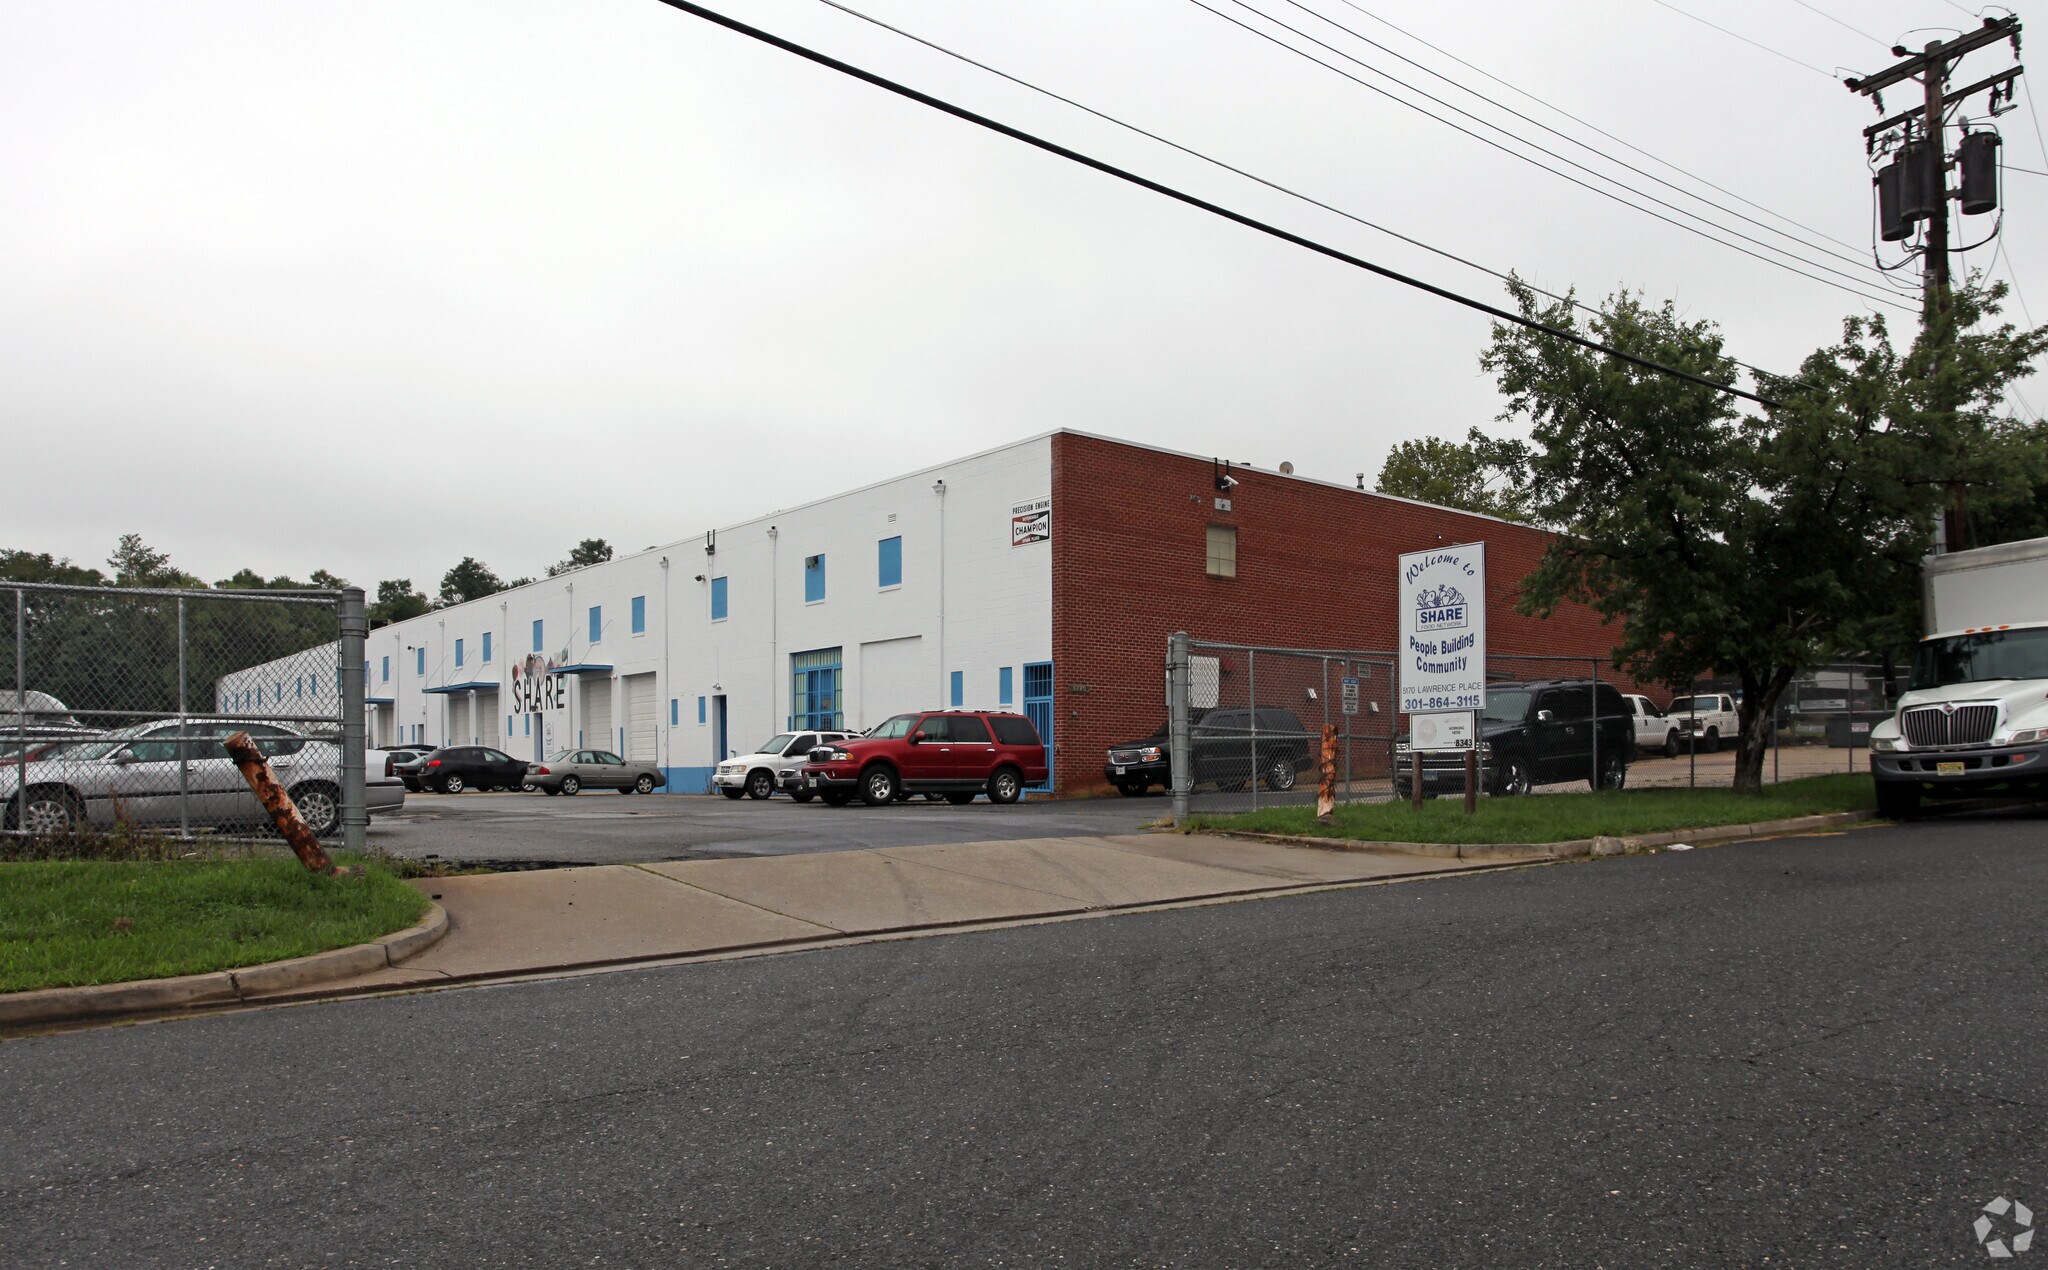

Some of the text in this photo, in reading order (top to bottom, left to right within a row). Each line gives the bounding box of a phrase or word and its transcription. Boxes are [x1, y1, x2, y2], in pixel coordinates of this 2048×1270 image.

[1012, 500, 1050, 515] PRECISION ENGINE
[1015, 521, 1047, 536] CHAMPION
[1406, 554, 1475, 586] Welcome to
[1420, 607, 1463, 624] SHARE
[1436, 620, 1463, 628] NETWORK
[1409, 632, 1475, 657] People Building
[1416, 656, 1468, 674] Community
[514, 673, 565, 714] SHARE
[1402, 681, 1483, 695] 5170 LAWRENCE PLACE
[1404, 694, 1480, 710] 301-864-3115
